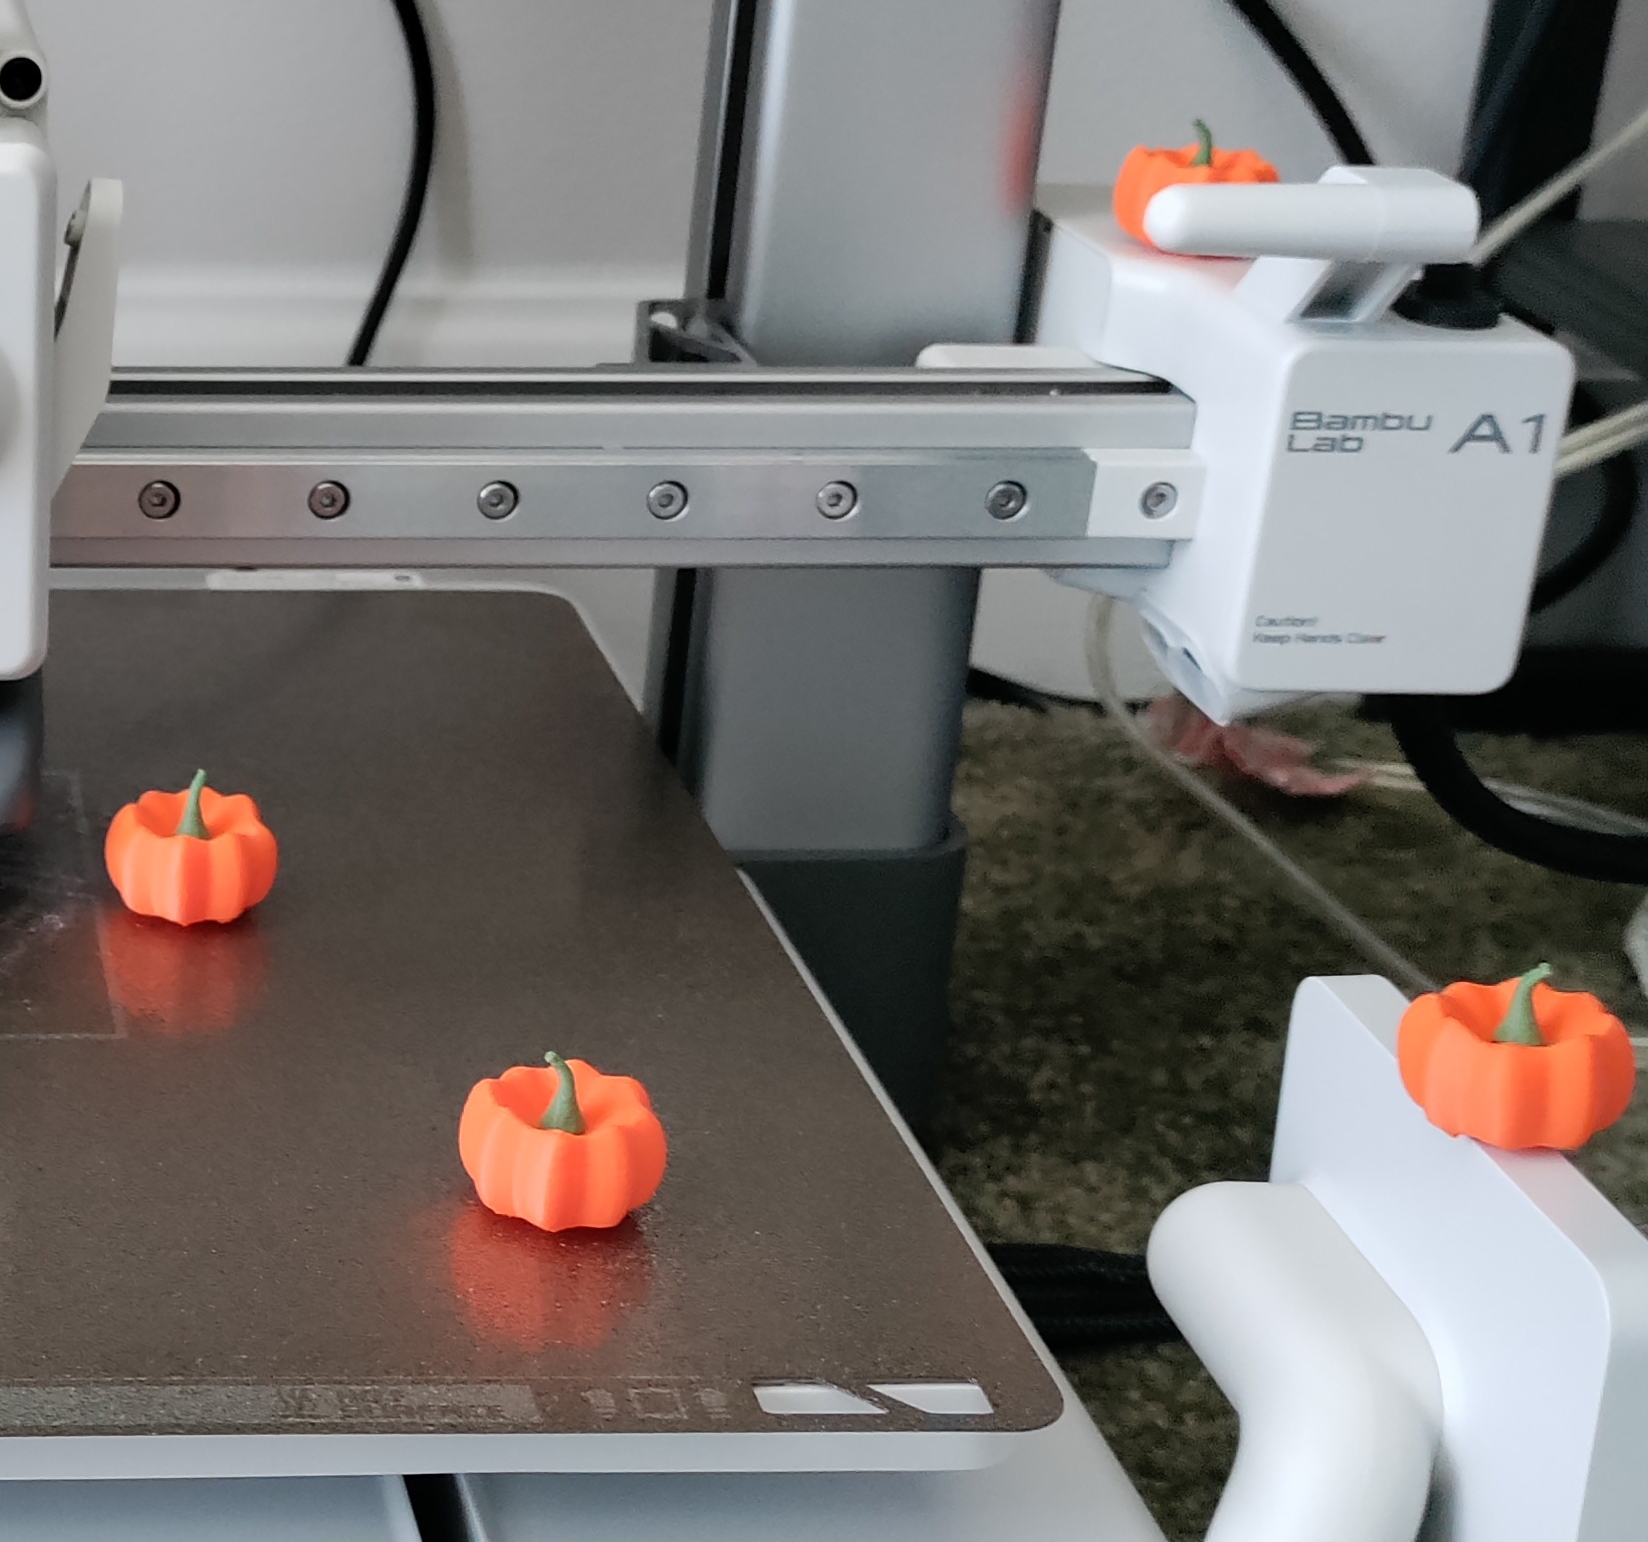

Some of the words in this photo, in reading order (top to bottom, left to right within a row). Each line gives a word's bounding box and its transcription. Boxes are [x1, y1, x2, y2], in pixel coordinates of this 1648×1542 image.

[1291, 411, 1434, 431] Bambu
[1286, 433, 1364, 453] Lab
[1447, 413, 1547, 454] A1
